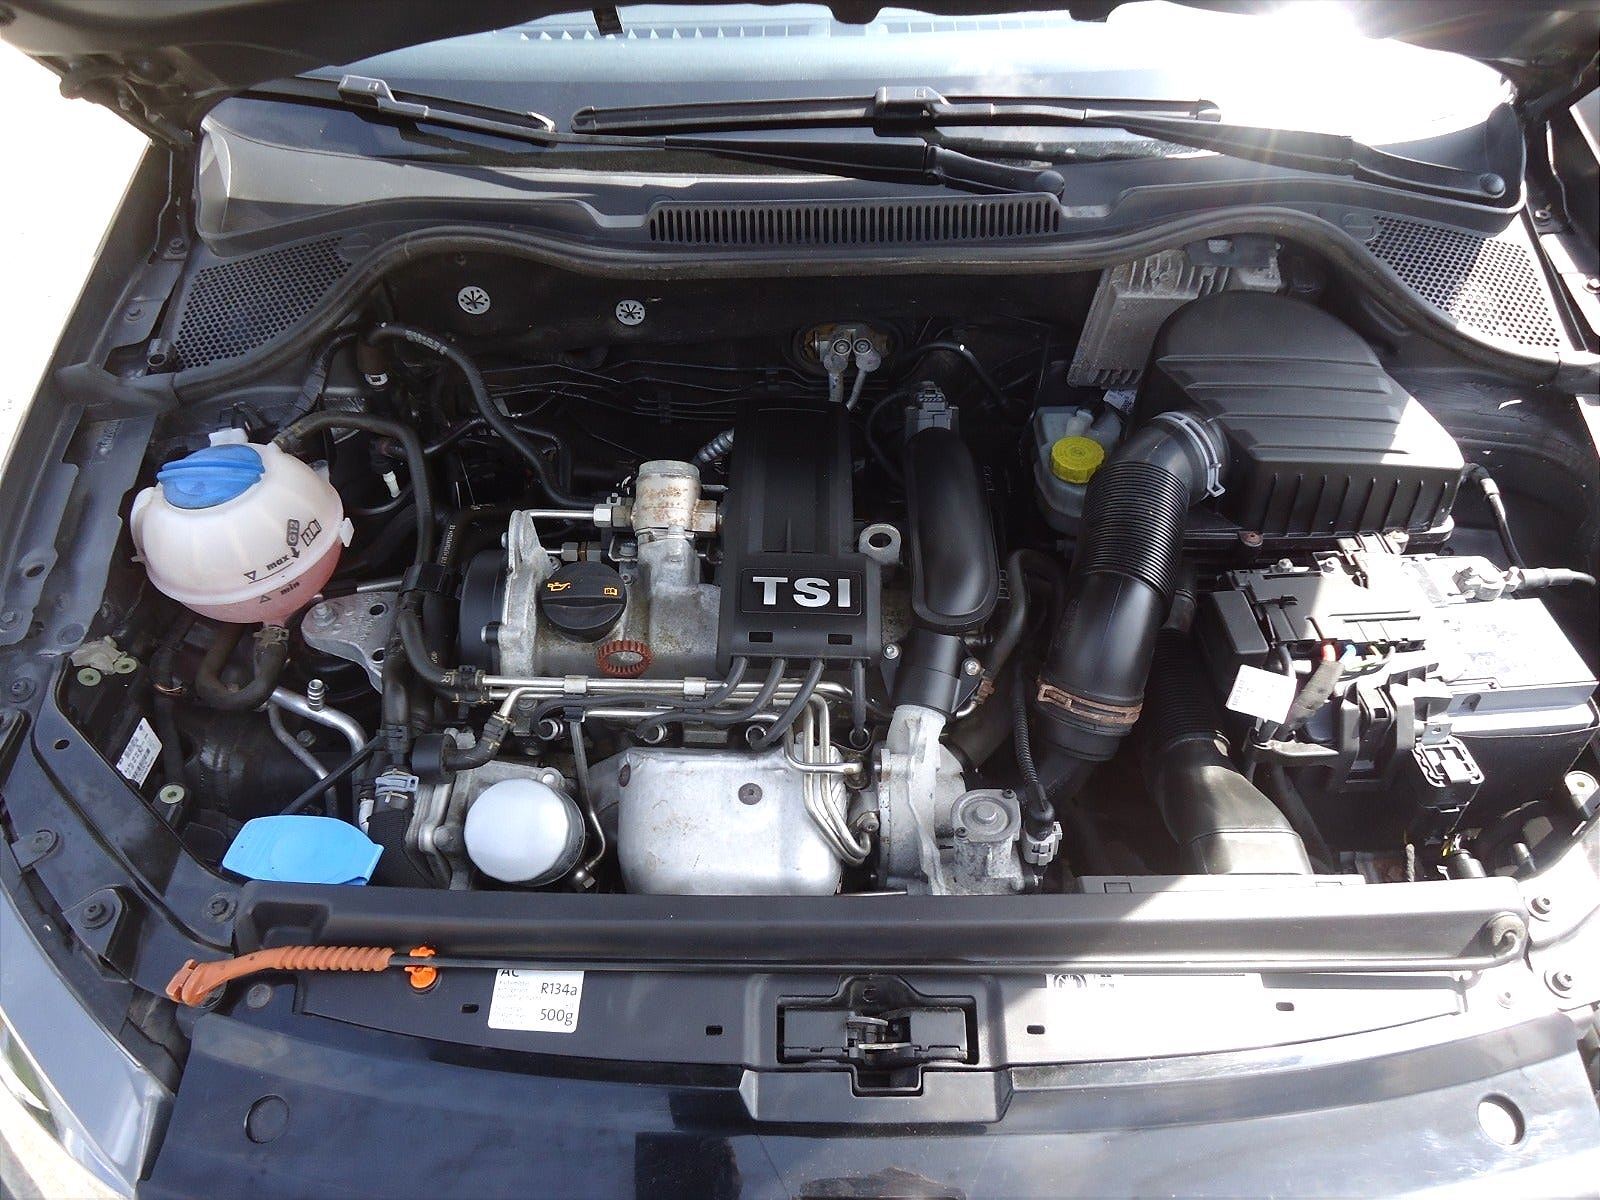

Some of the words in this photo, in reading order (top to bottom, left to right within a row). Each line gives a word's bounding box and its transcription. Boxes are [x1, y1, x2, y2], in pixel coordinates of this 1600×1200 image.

[266, 555, 290, 571] max
[280, 581, 300, 595] min
[752, 576, 851, 607] TSI
[540, 982, 578, 996] R134a
[539, 1008, 574, 1026] 500g
